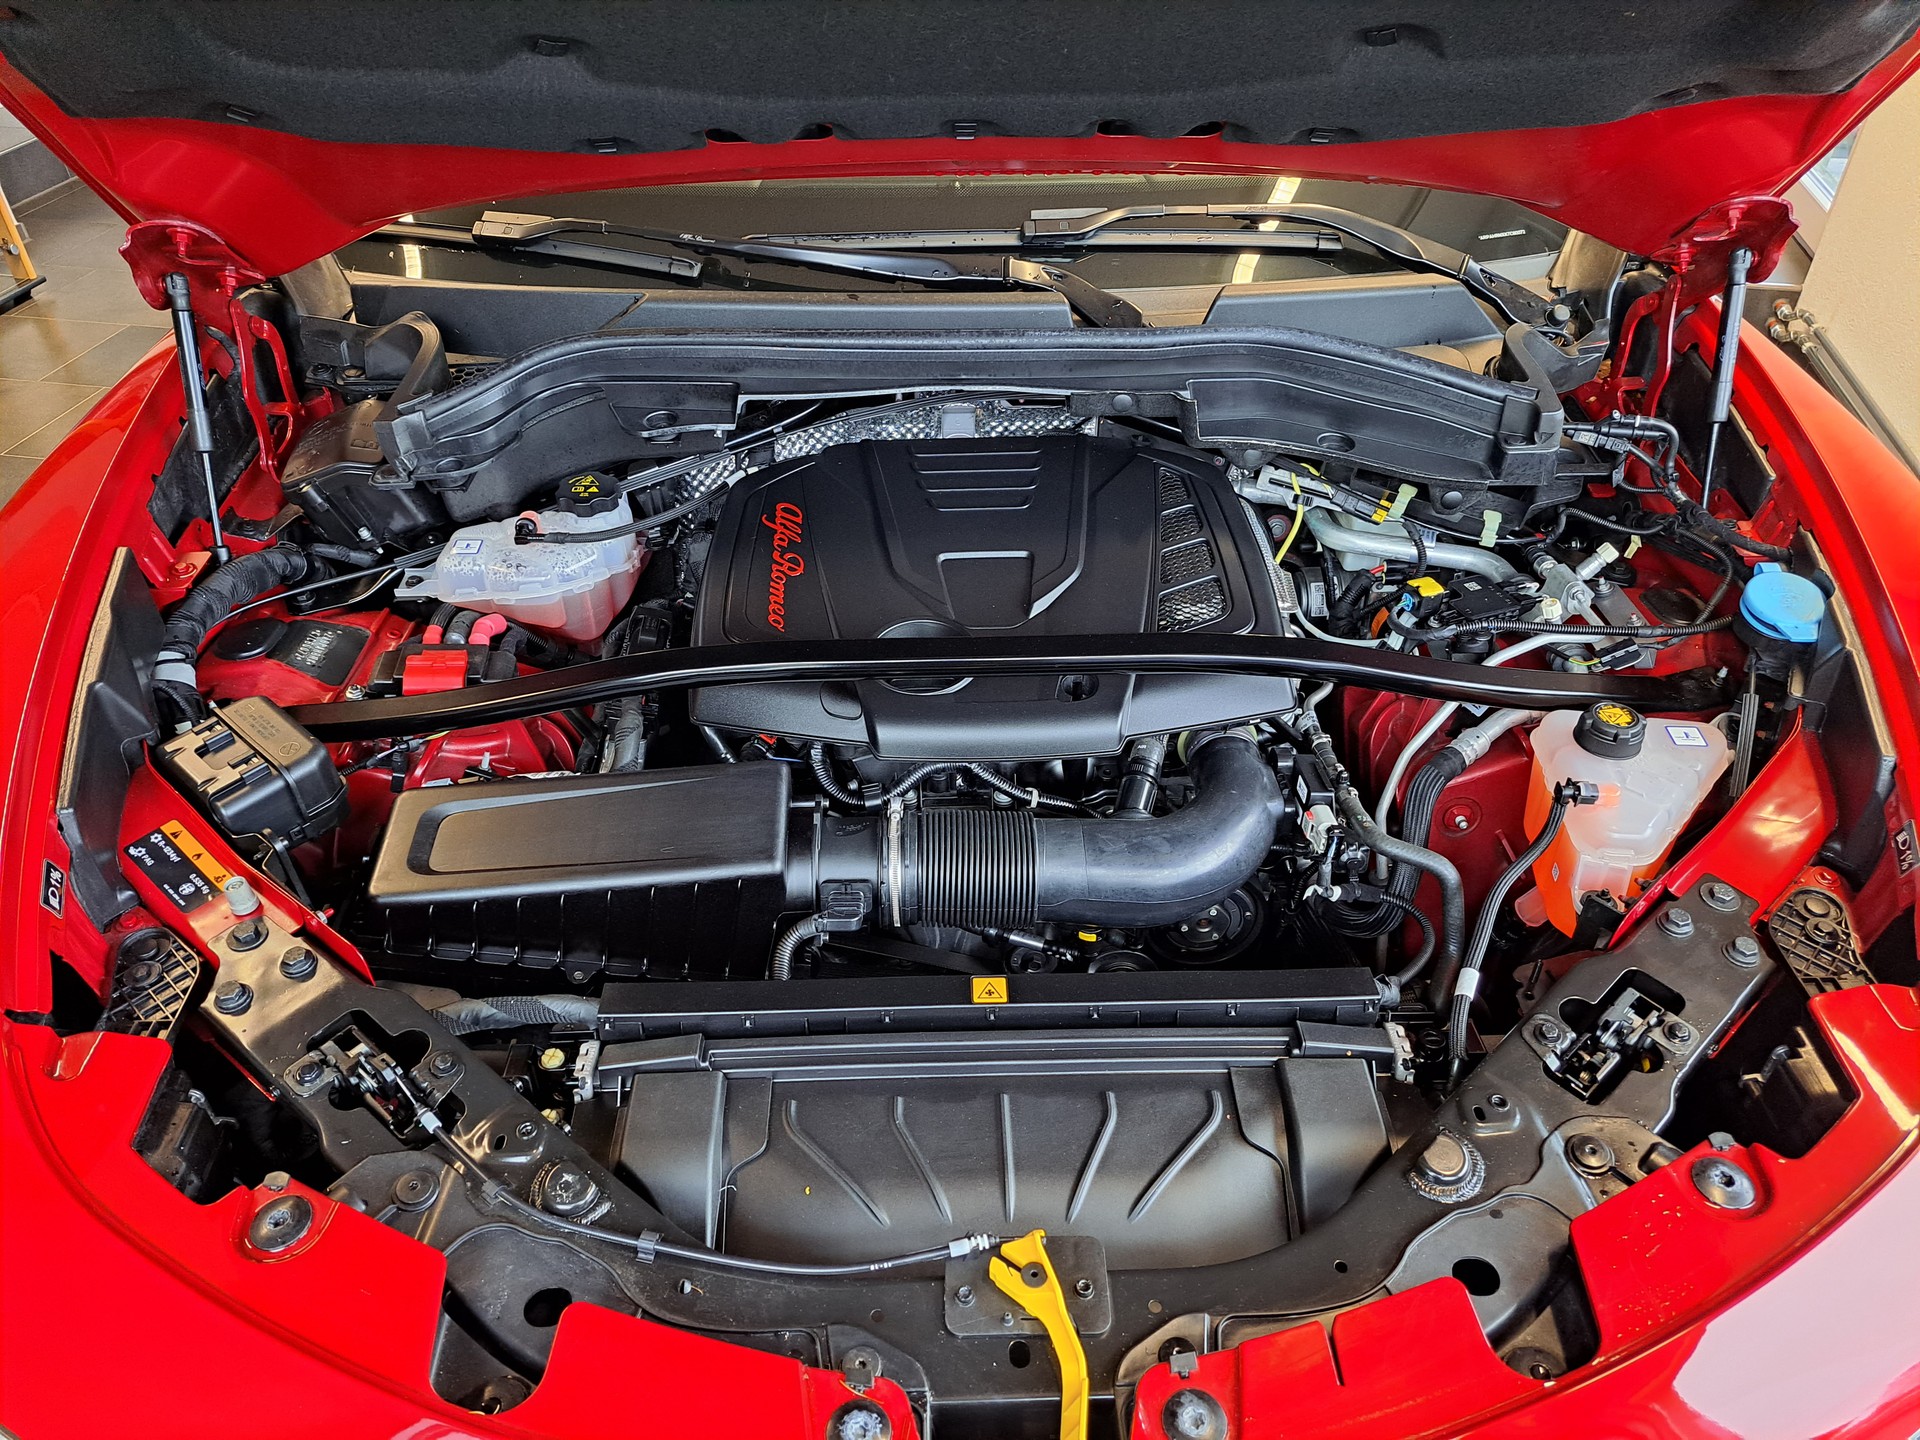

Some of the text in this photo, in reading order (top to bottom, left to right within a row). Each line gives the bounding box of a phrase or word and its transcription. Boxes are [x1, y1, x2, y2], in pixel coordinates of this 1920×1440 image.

[761, 502, 805, 632] Alfa Romeo
[141, 854, 155, 866] PAG
[50, 868, 62, 888] 1%
[200, 884, 210, 894] Kg
